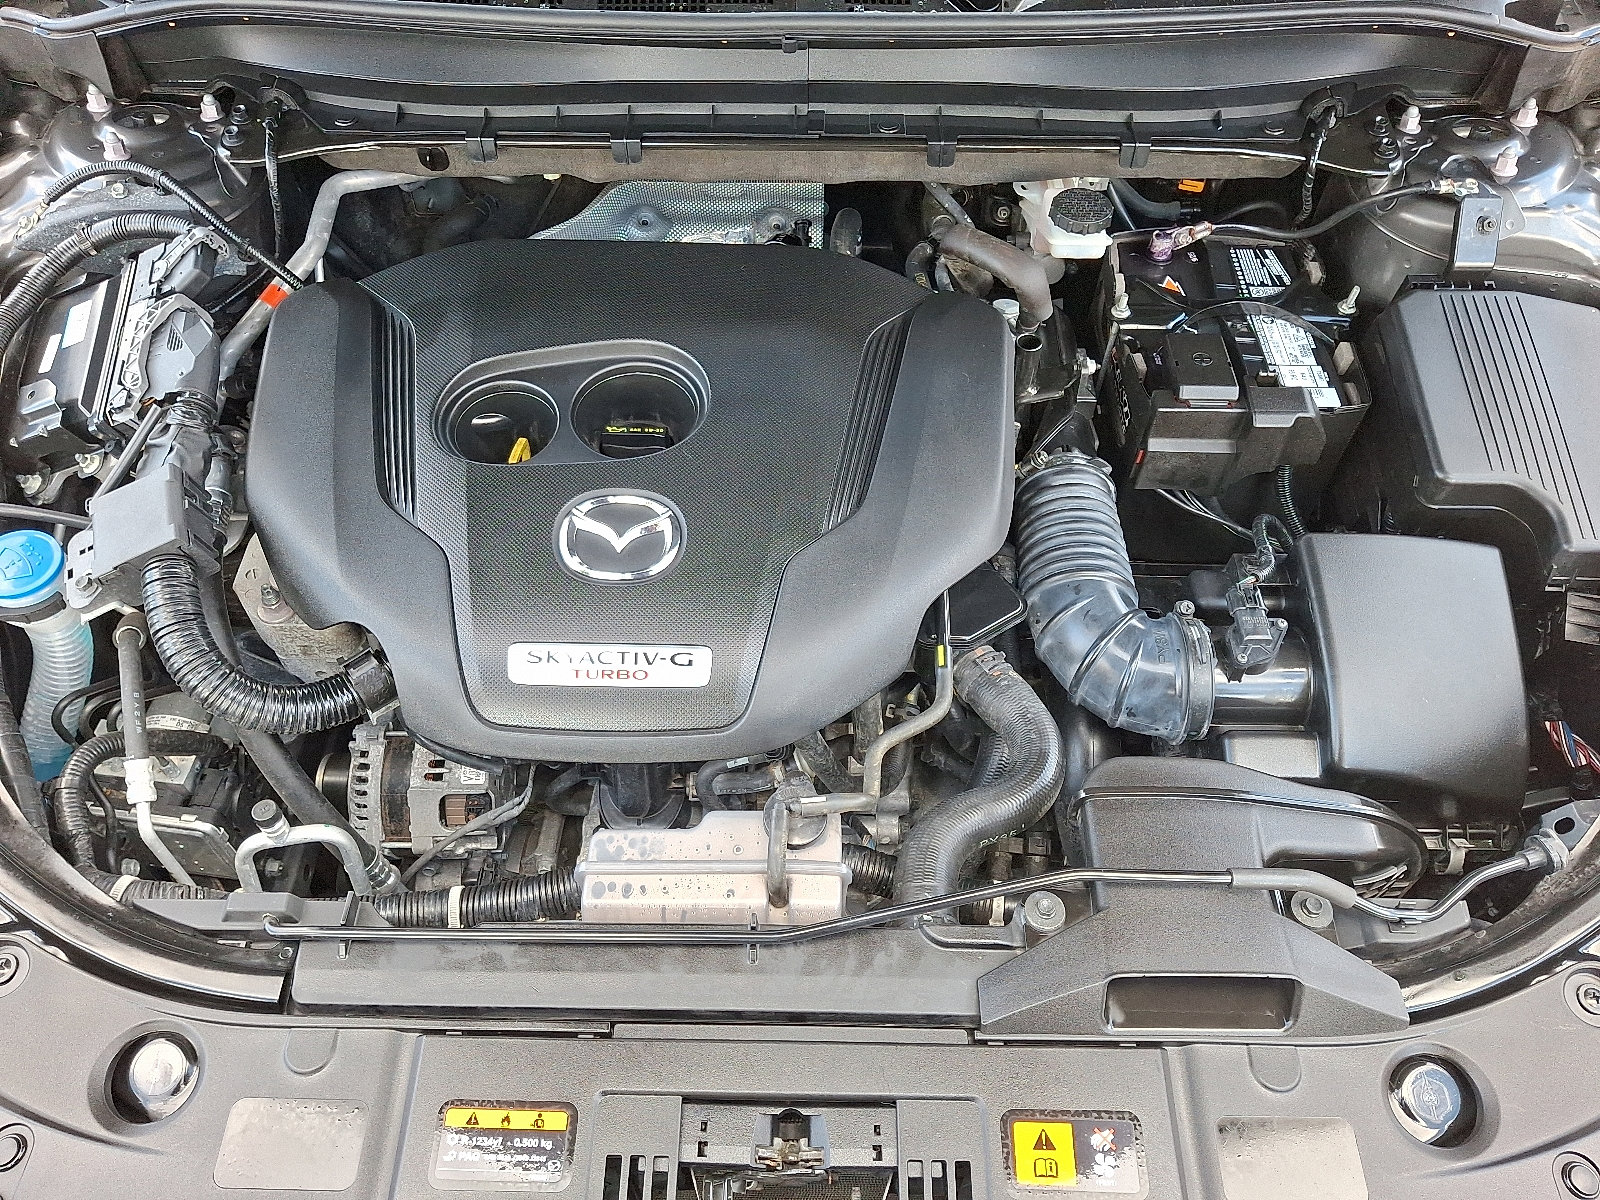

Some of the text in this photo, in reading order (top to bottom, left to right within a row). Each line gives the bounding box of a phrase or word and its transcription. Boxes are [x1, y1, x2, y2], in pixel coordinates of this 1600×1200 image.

[526, 650, 694, 667] SKYACTIV-G
[573, 669, 649, 681] TURBO
[513, 1137, 539, 1148] 0.500
[540, 1138, 553, 1151] kg
